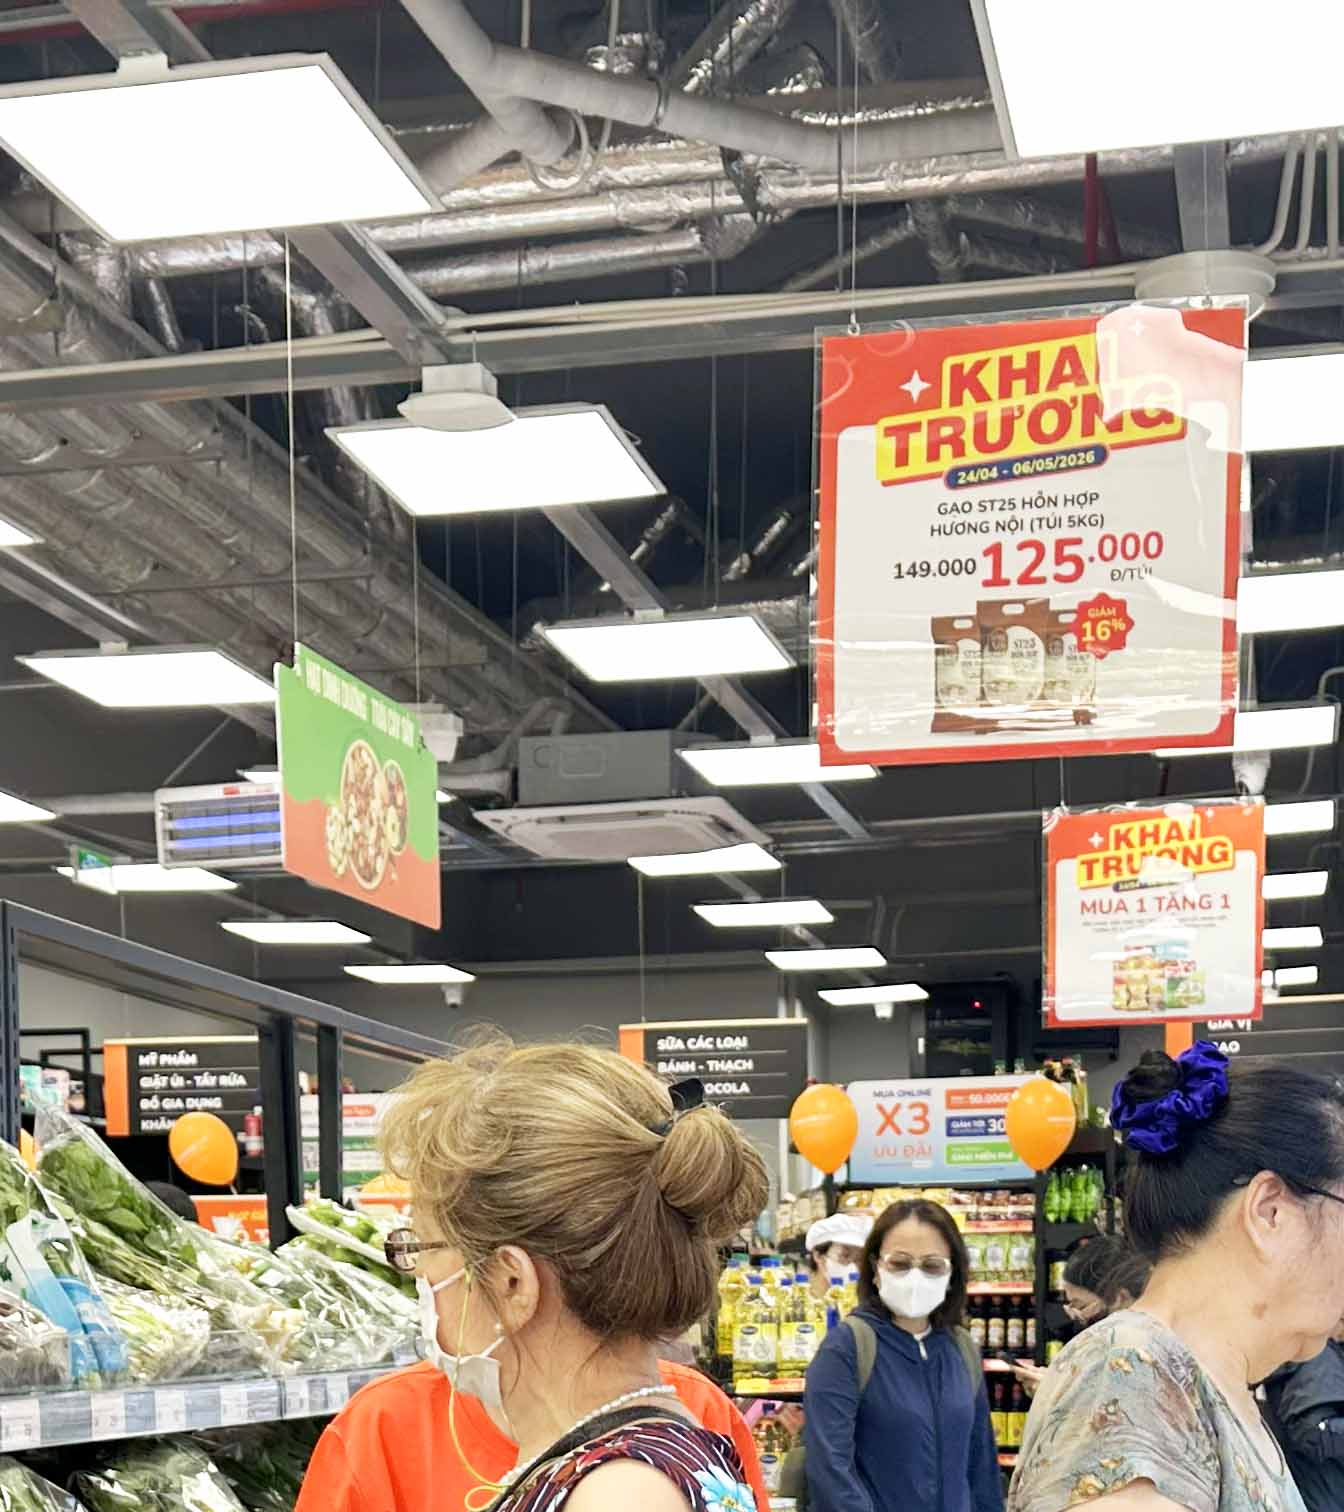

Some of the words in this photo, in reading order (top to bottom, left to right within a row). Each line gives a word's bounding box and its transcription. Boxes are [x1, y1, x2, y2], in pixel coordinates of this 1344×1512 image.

[958, 466, 998, 484] 24/04
[937, 501, 973, 518] GẠO
[978, 498, 1016, 512] ST25
[1063, 491, 1099, 510] HỢP
[930, 519, 990, 537] HƯƠNG
[996, 515, 1024, 535] NỘI
[1030, 513, 1062, 533] (TÚI
[1068, 513, 1105, 529] 5KG)
[893, 558, 977, 580] 149.000
[980, 531, 1164, 588] 125.000
[1080, 896, 1129, 915] MUA
[1137, 898, 1147, 913] 1
[1222, 894, 1231, 910] 1
[657, 1034, 684, 1050] SỮA
[687, 1034, 714, 1049] CÁC
[715, 1036, 748, 1051] LOẠI
[657, 1059, 696, 1073] BÁNH
[706, 1059, 753, 1073] THẠCH
[702, 1081, 751, 1095] OCOLA
